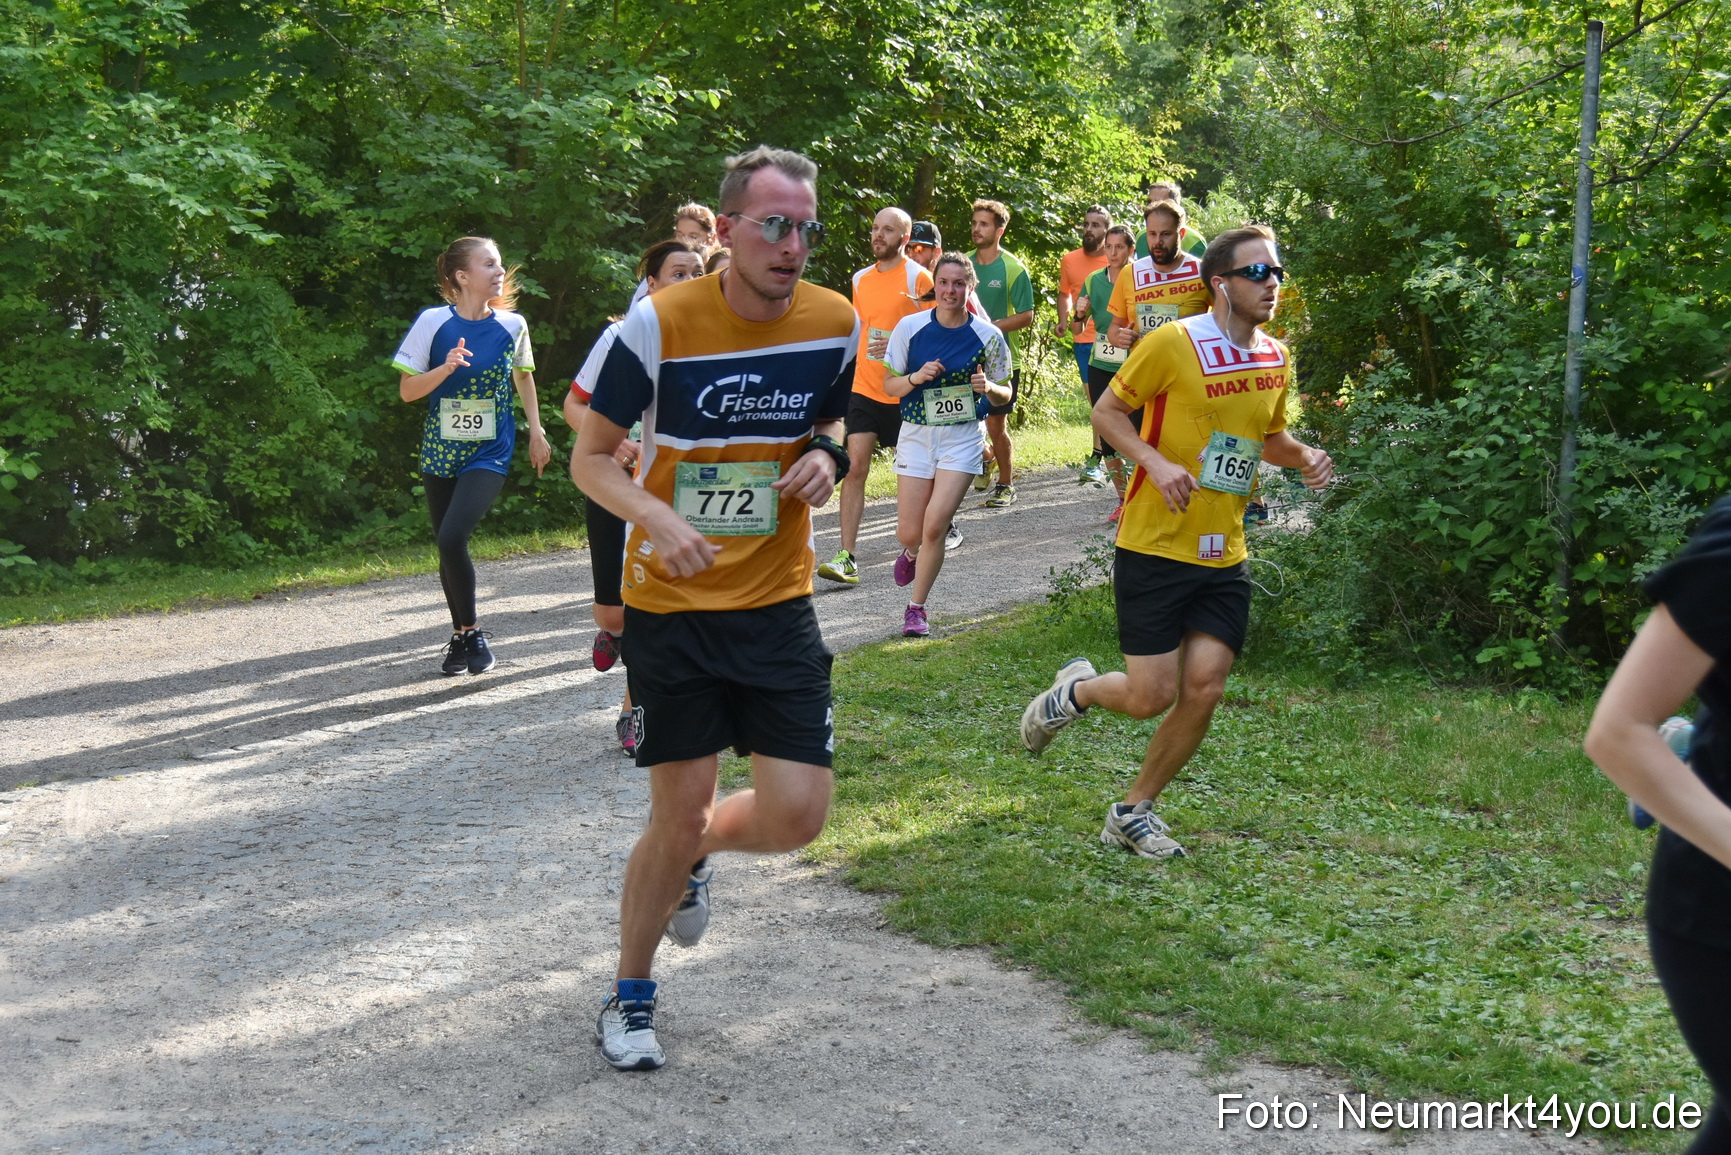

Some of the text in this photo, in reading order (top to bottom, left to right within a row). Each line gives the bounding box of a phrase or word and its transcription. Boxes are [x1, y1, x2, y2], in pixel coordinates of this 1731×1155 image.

[1135, 282, 1206, 303] MAX BÖGL
[1102, 344, 1115, 355] 23
[1205, 372, 1285, 399] MAX BÖGL
[719, 389, 814, 413] Fischer
[935, 398, 964, 415] 206
[451, 414, 483, 429] 259
[727, 411, 806, 423] AUTOMOBILE
[1214, 453, 1255, 481] 1650
[697, 489, 755, 516] 772
[685, 514, 730, 524] Oberlander
